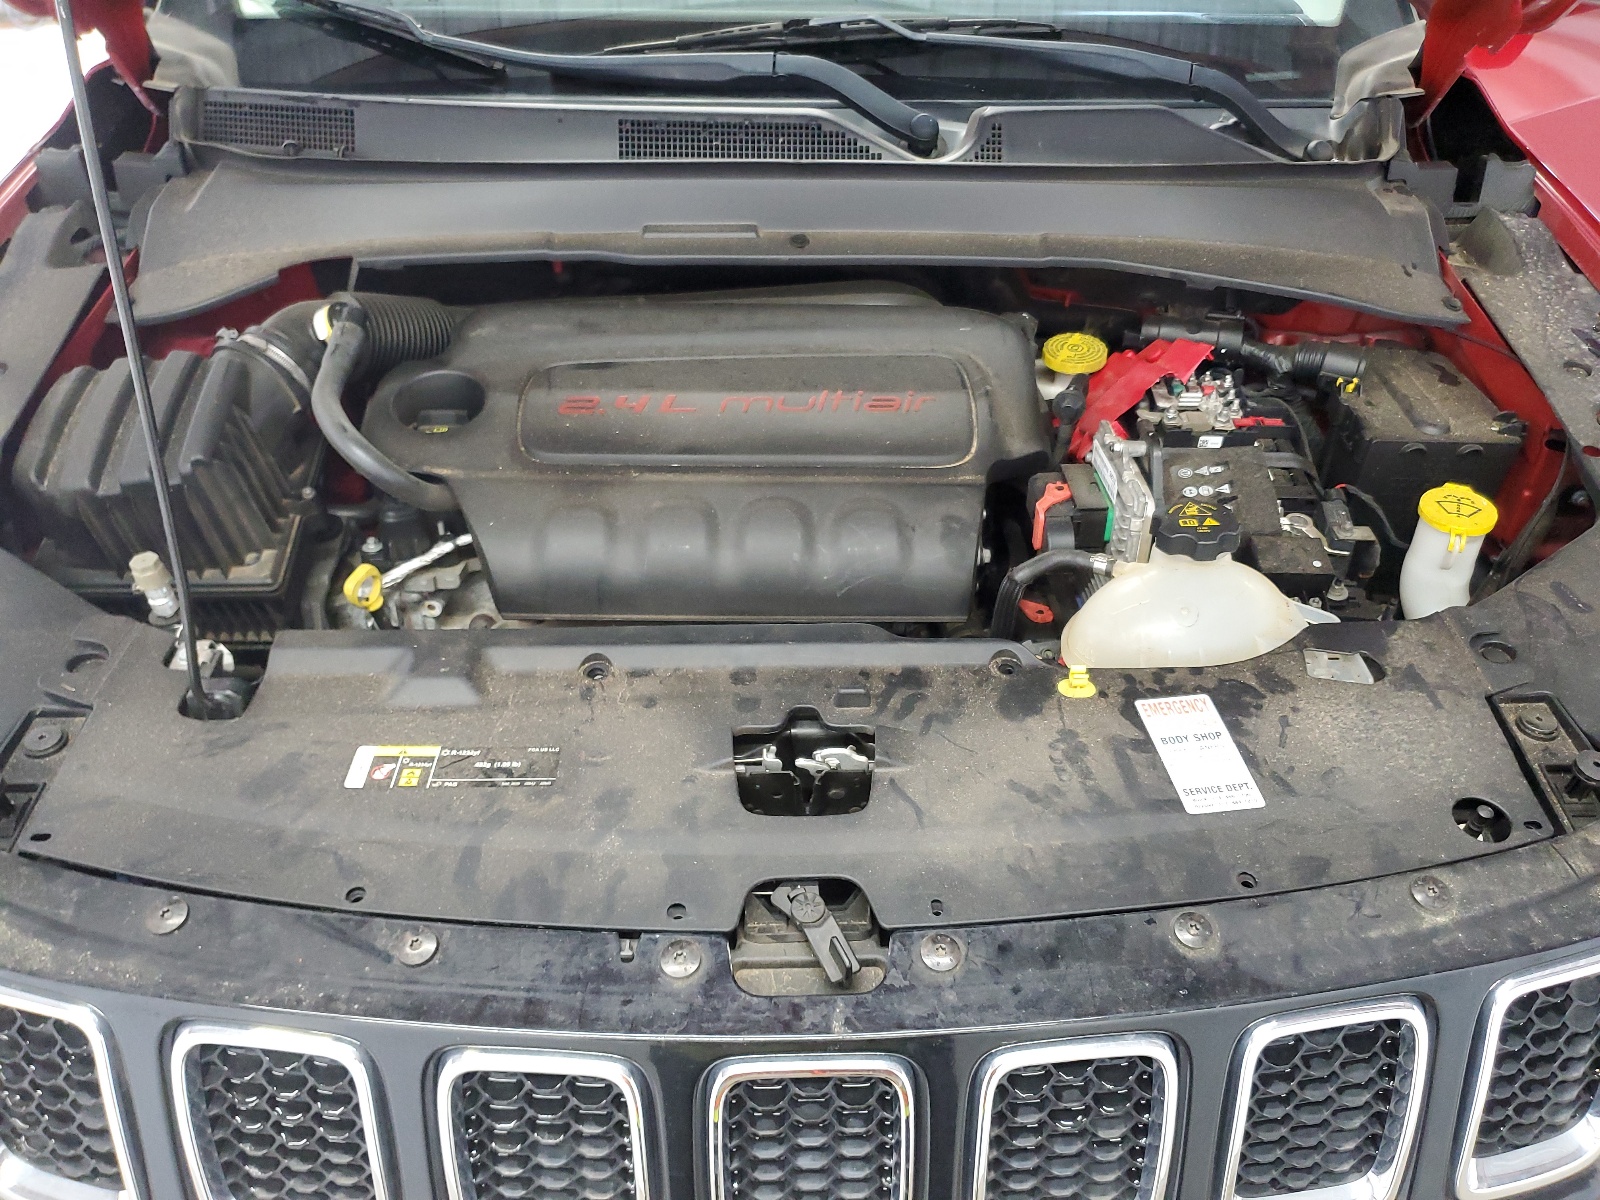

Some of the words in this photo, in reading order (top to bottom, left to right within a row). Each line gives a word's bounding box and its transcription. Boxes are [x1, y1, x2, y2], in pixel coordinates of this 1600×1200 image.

[719, 390, 937, 414] multiair
[1141, 698, 1210, 718] EMERGENCY
[1160, 735, 1189, 745] BODY
[1193, 731, 1222, 742] SHOP
[1182, 785, 1224, 797] SERVICE
[1225, 783, 1253, 792] DEPT.
